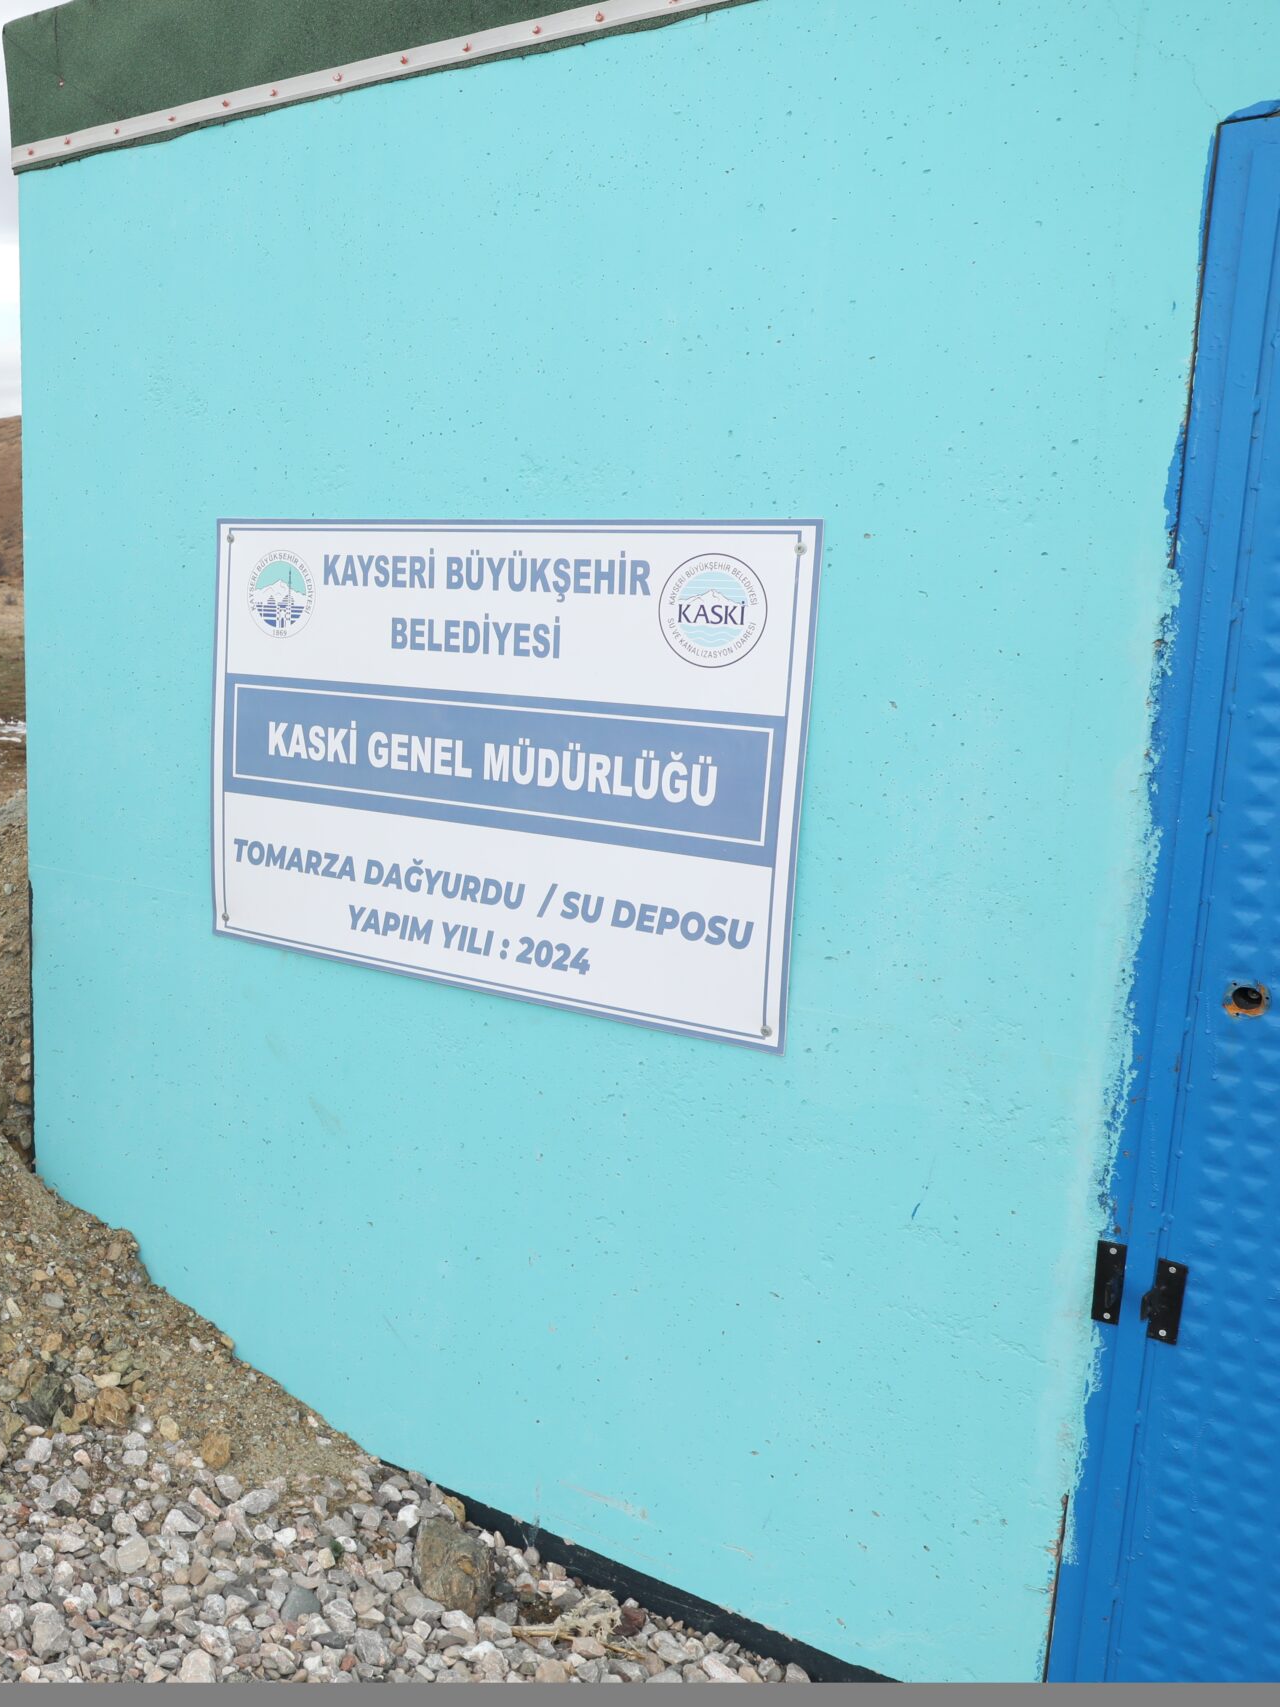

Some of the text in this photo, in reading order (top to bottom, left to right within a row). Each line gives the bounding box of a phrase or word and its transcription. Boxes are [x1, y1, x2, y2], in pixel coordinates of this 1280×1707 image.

[323, 548, 651, 603] KAYSERİ BÜYÜKŞEHİR
[391, 613, 561, 659] BELEDİYESİ
[678, 600, 746, 625] KASKİ
[268, 720, 718, 807] KASKİ GENEL MÜDÜRLÜĞÜ
[233, 838, 356, 882] TOMARZA
[363, 858, 526, 910] DAĞYURDU
[560, 891, 608, 926] SU
[610, 899, 755, 951] DEPOSU
[347, 905, 434, 945] YAPIM
[442, 924, 495, 957] YILI
[518, 936, 591, 976] 2024
